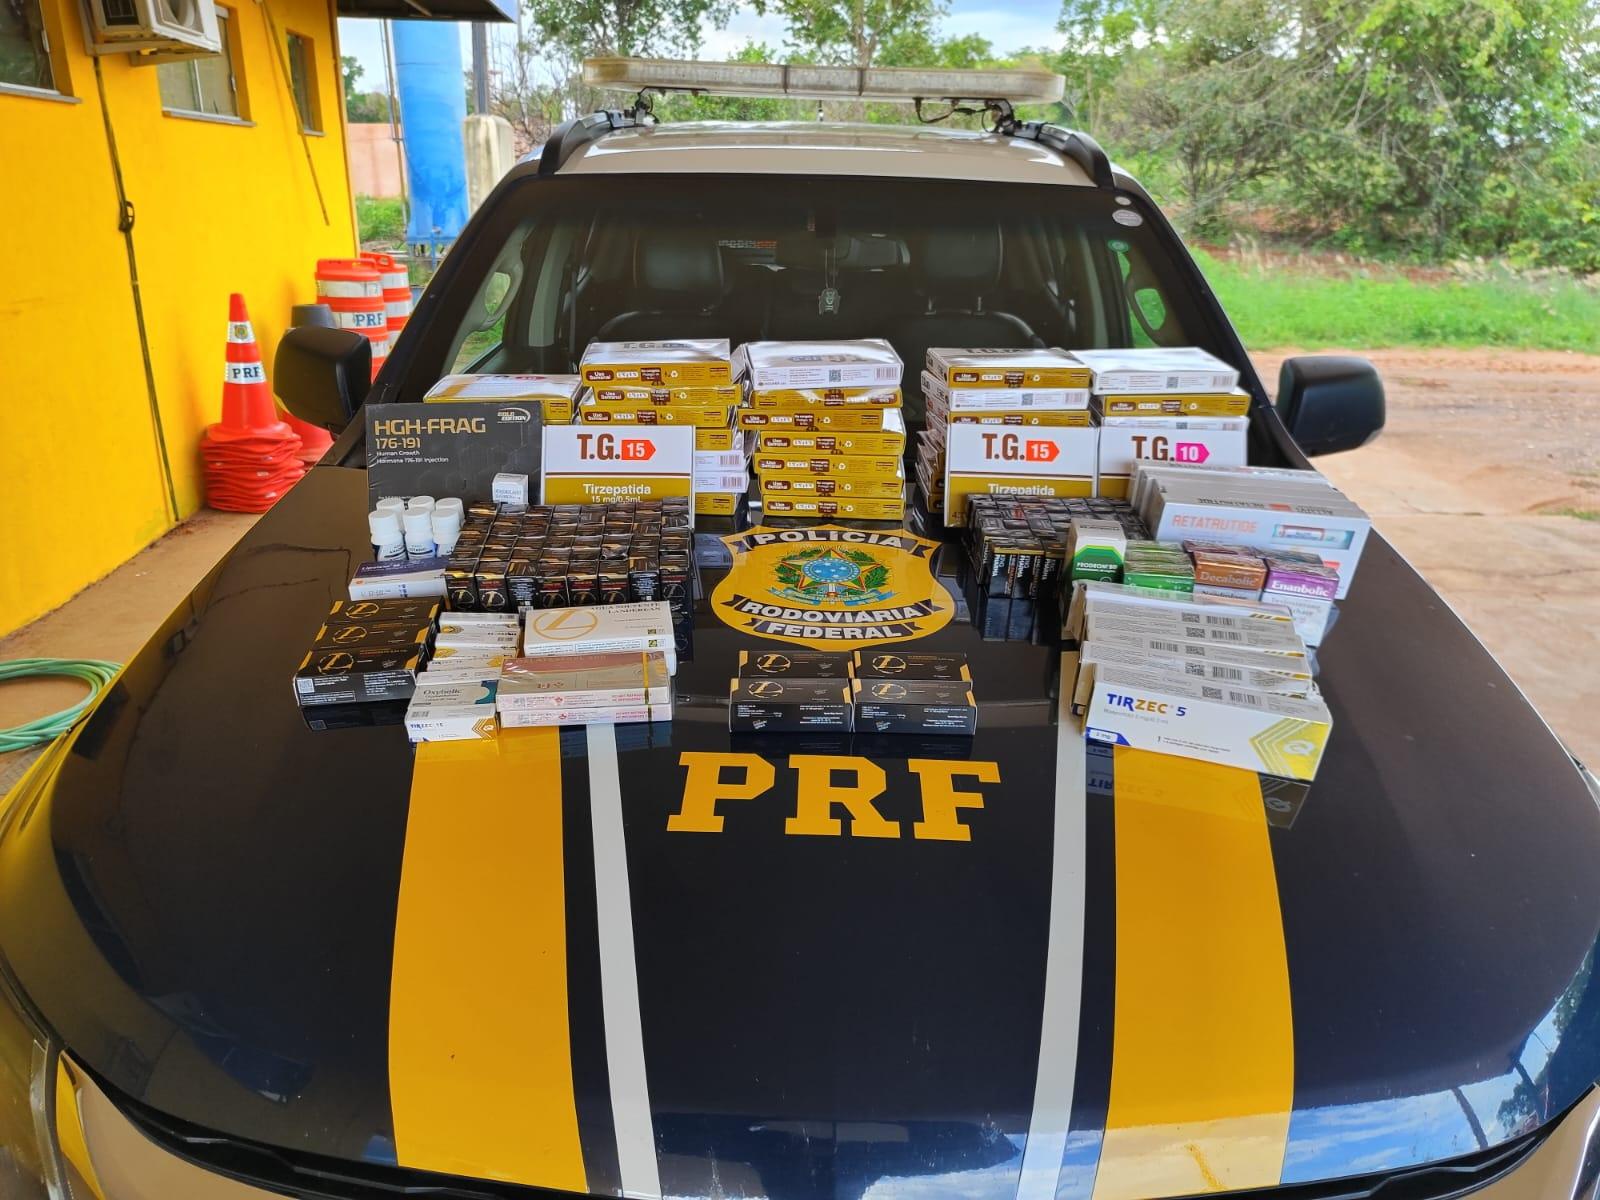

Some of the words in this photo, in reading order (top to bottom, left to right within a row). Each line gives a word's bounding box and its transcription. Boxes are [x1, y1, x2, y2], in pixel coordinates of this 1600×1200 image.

[356, 313, 384, 326] PRF
[232, 365, 260, 378] PRF
[374, 418, 486, 436] HGH-FRAG
[375, 438, 420, 449] 176-191
[576, 433, 620, 460] T.G.
[626, 442, 645, 458] 15
[982, 433, 1025, 460] T.G.
[1031, 444, 1049, 458] 15
[1131, 436, 1175, 462] T.G.
[1180, 446, 1198, 462] 10
[582, 483, 652, 495] Tirzepatida
[1172, 514, 1259, 534] RETATRUTIDE
[1200, 571, 1255, 586] Decabolic
[1271, 580, 1329, 597] Enanbolic
[766, 624, 902, 639] FEDERAL
[1106, 693, 1168, 714] TIRZEC
[1176, 706, 1187, 716] 5
[666, 751, 1001, 842] PRF
